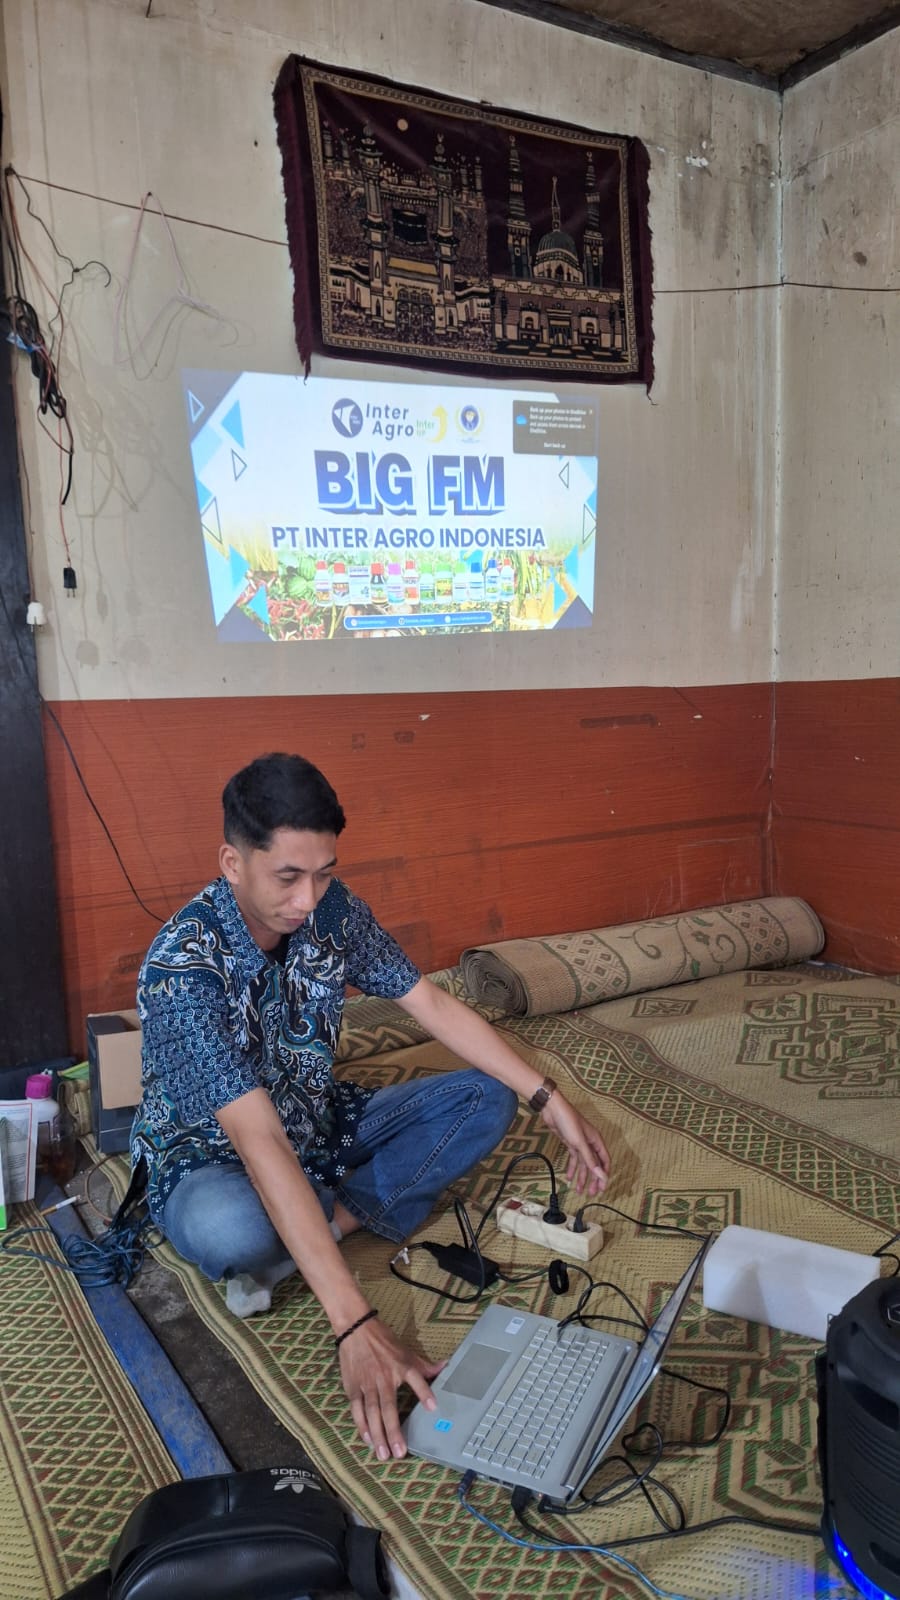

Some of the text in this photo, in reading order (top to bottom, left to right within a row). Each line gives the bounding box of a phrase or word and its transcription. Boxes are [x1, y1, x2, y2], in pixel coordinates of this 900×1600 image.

[365, 403, 409, 420] Inter
[372, 421, 414, 440] Agro
[313, 450, 506, 516] BIG FM
[271, 527, 546, 549] PT INTER AGRO INDONESIA
